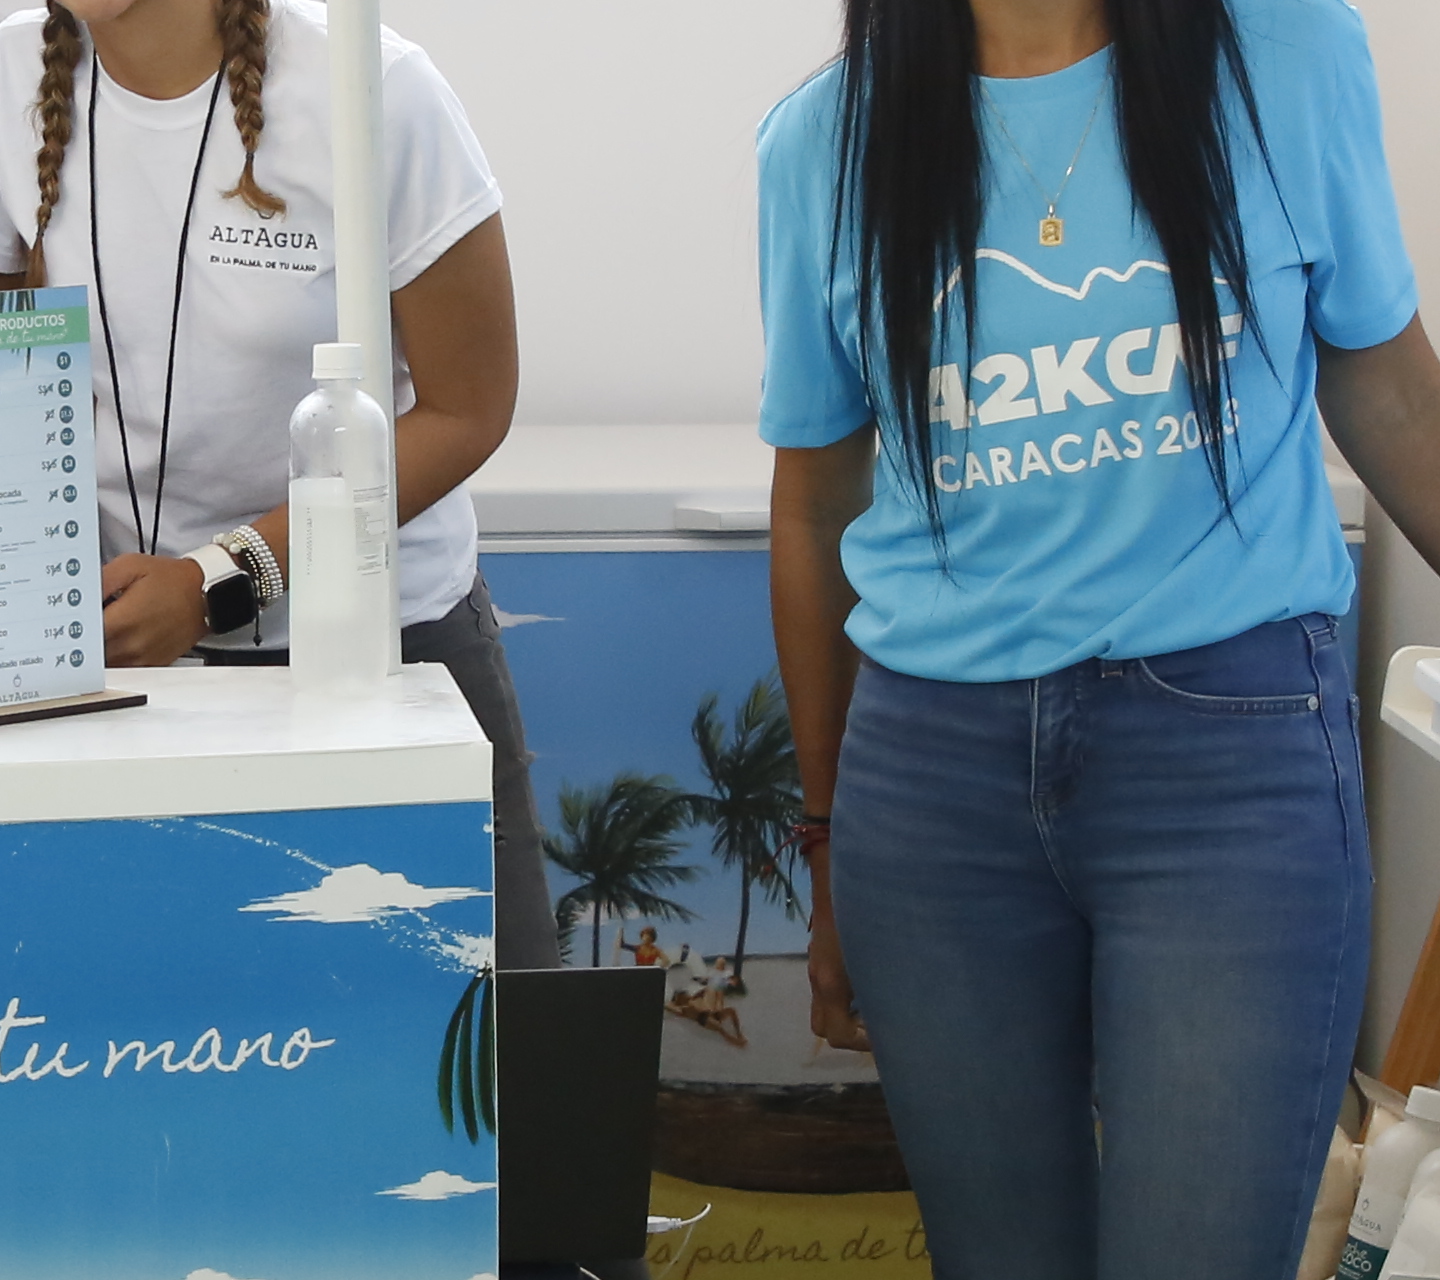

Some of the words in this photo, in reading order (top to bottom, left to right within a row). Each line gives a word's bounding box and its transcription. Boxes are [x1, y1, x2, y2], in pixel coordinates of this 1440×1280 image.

[210, 225, 318, 250] ALTAGUA
[222, 256, 232, 264] LA
[265, 261, 276, 269] DE
[280, 262, 290, 270] TU
[6, 331, 19, 344] de
[932, 420, 1144, 493] CARACAS
[1156, 398, 1239, 456] 203
[102, 1022, 337, 1078] mano
[841, 1225, 897, 1261] de
